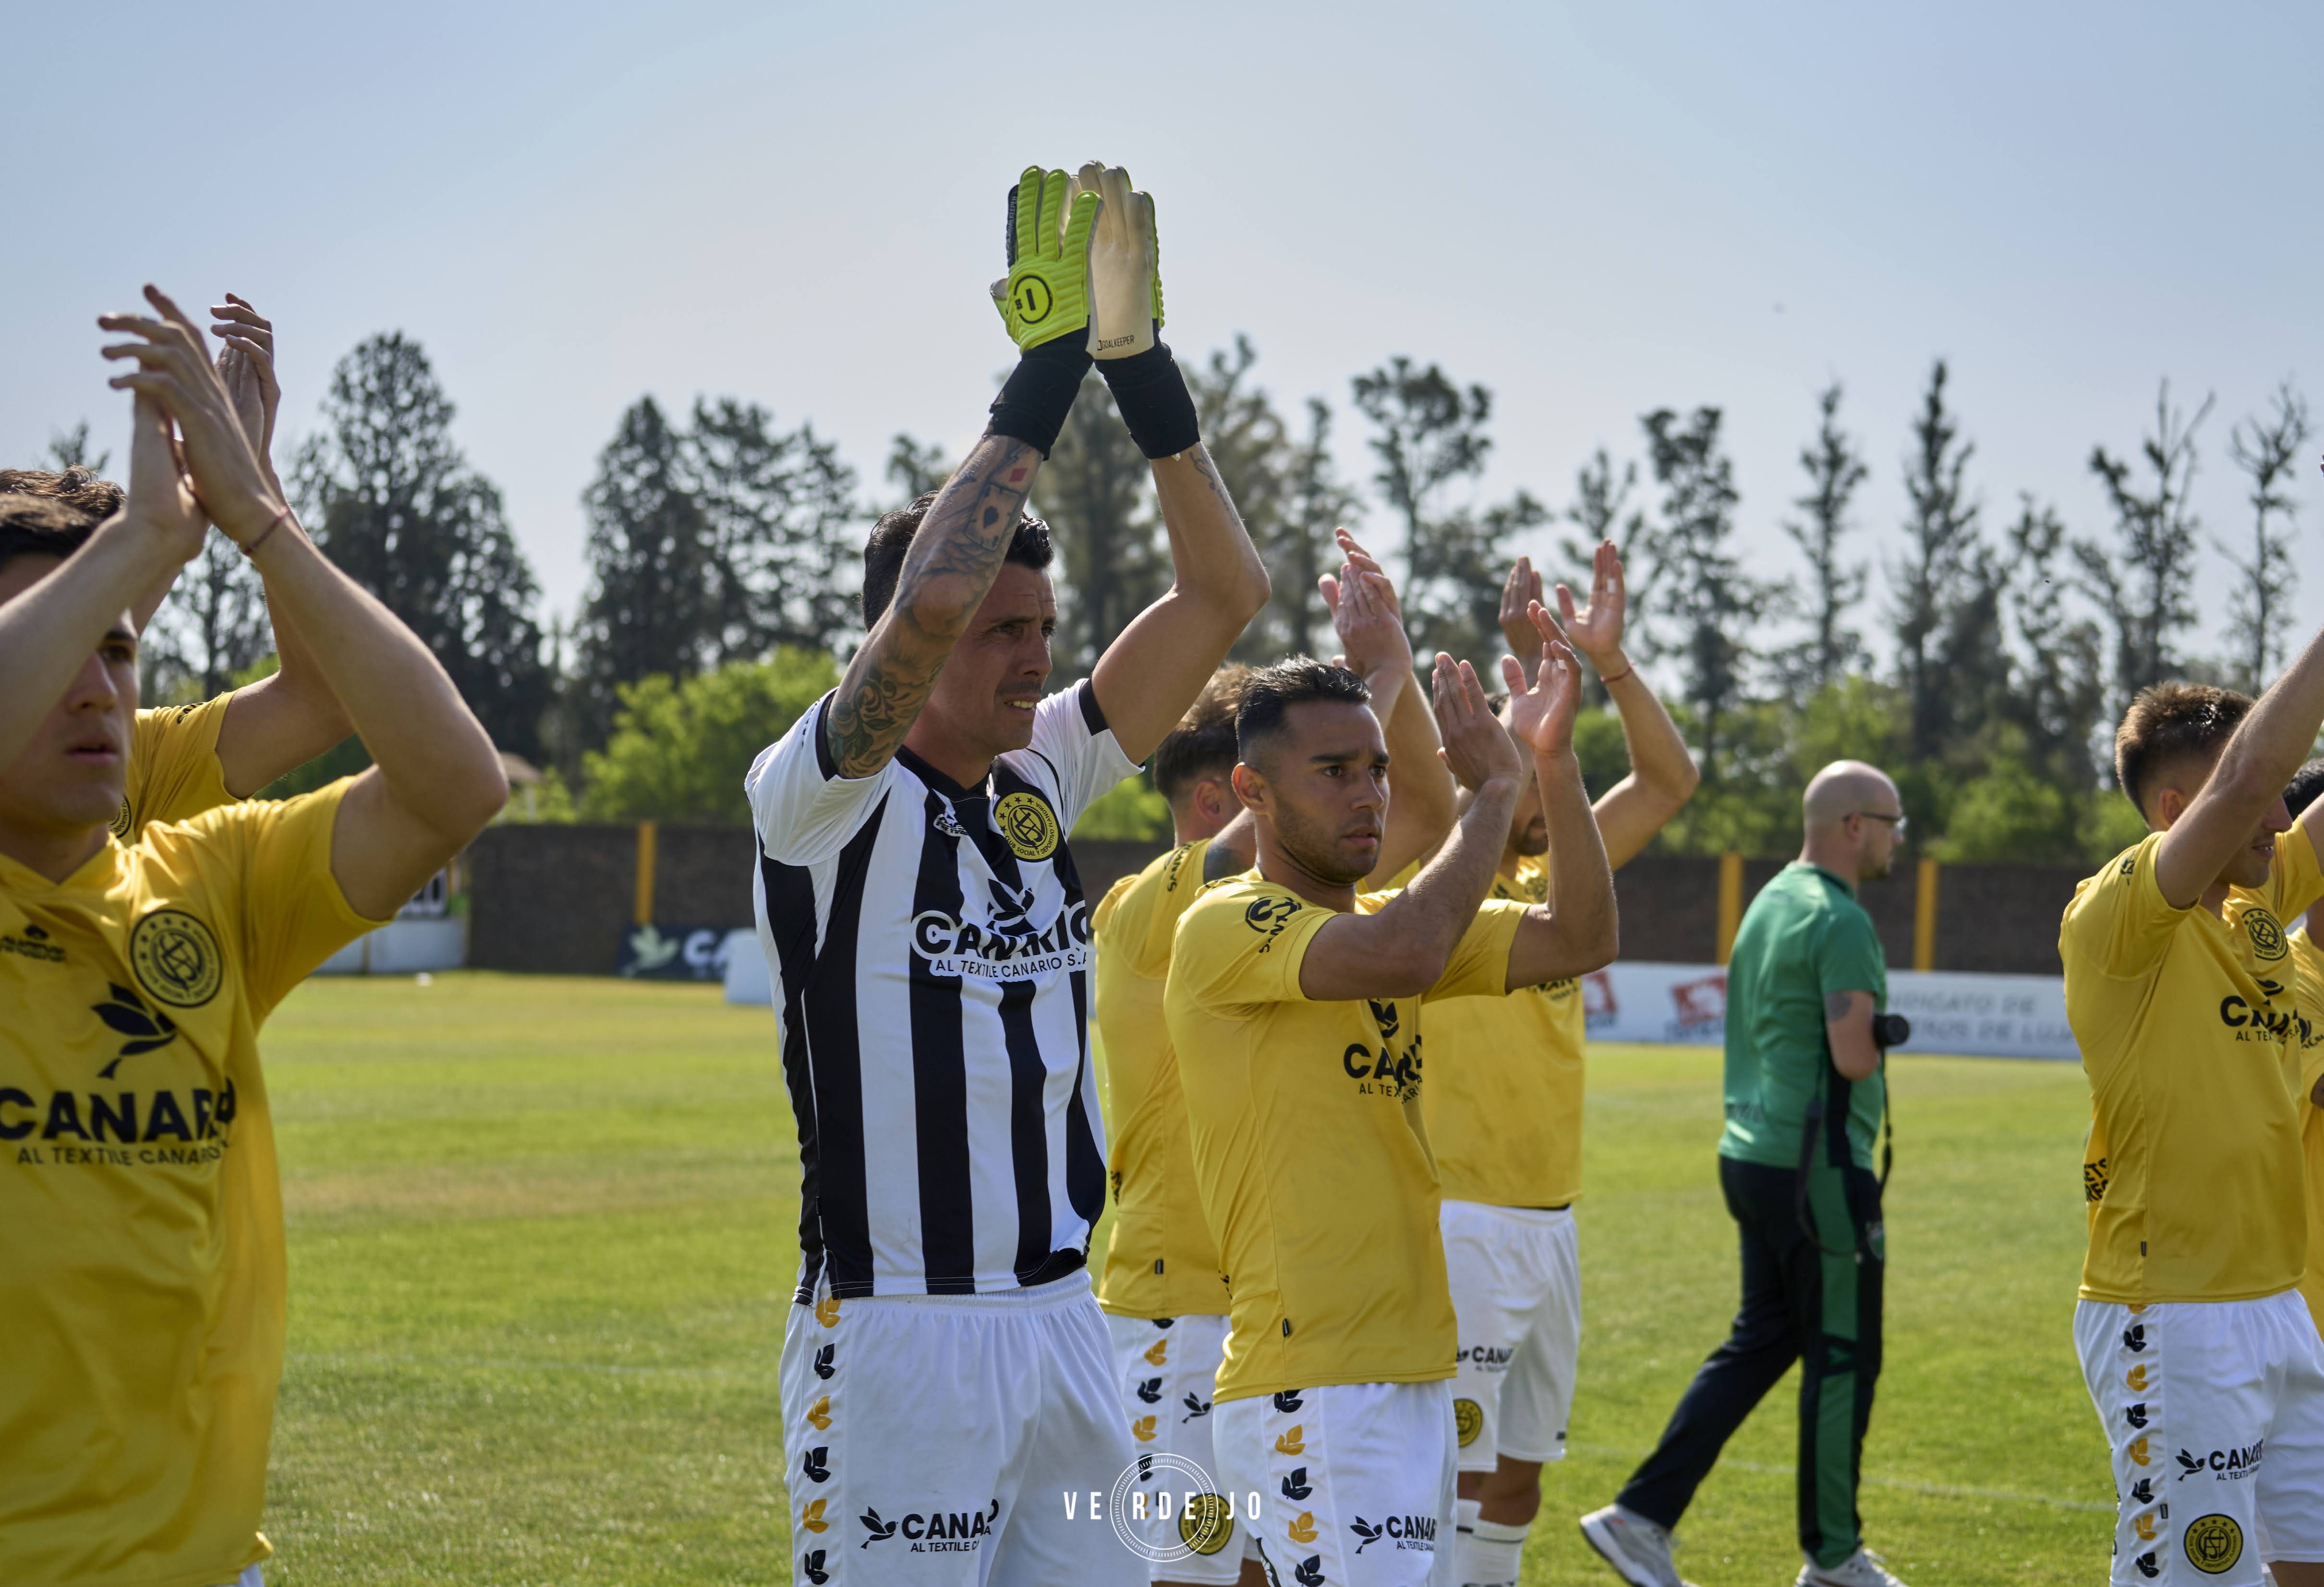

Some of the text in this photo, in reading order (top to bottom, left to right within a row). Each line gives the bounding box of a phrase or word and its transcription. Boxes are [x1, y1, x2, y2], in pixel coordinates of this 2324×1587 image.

[1036, 802, 1054, 827] FLANDRIA
[1041, 829, 1054, 854] DEPORTIVO
[1016, 847, 1036, 856] SOCIAL
[935, 960, 954, 972] AL
[1002, 957, 1062, 978] CANARIO
[1359, 1083, 1373, 1094] AL
[17, 1147, 44, 1164] AL
[2216, 1473, 2227, 1481] AL
[910, 1542, 926, 1552] AL
[928, 1541, 970, 1552] TEXTILE
